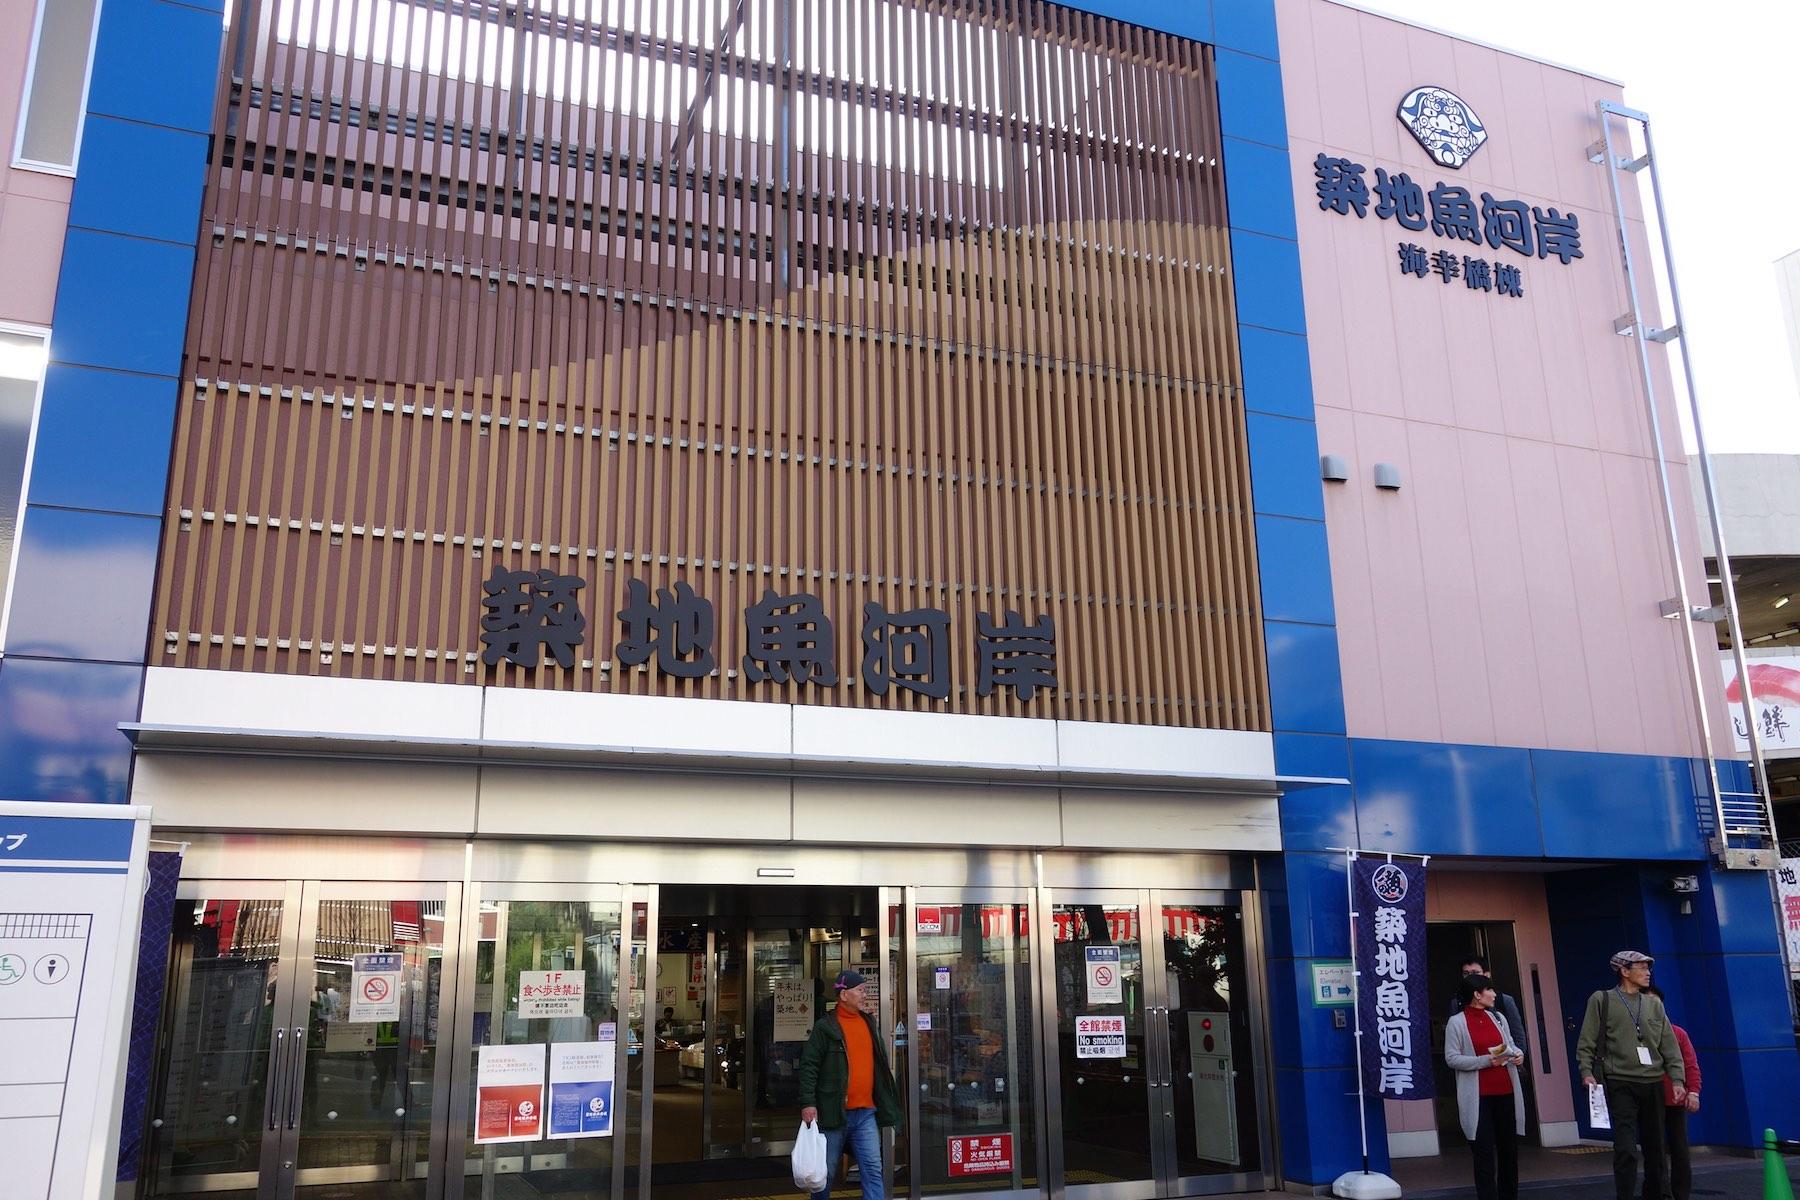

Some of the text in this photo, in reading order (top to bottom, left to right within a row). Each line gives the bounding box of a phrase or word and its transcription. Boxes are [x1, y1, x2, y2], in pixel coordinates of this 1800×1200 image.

[1314, 153, 1585, 265] 築地魚河岸
[1398, 242, 1523, 298] 海幸橋棟
[480, 565, 1058, 701] 築地魚河岸
[0, 833, 28, 851] プ
[523, 984, 582, 997] 食べ歩き禁止
[1375, 906, 1415, 1095] 築地魚河岸
[1079, 1020, 1122, 1032] 全館禁煙
[1080, 1035, 1122, 1046] No smoking
